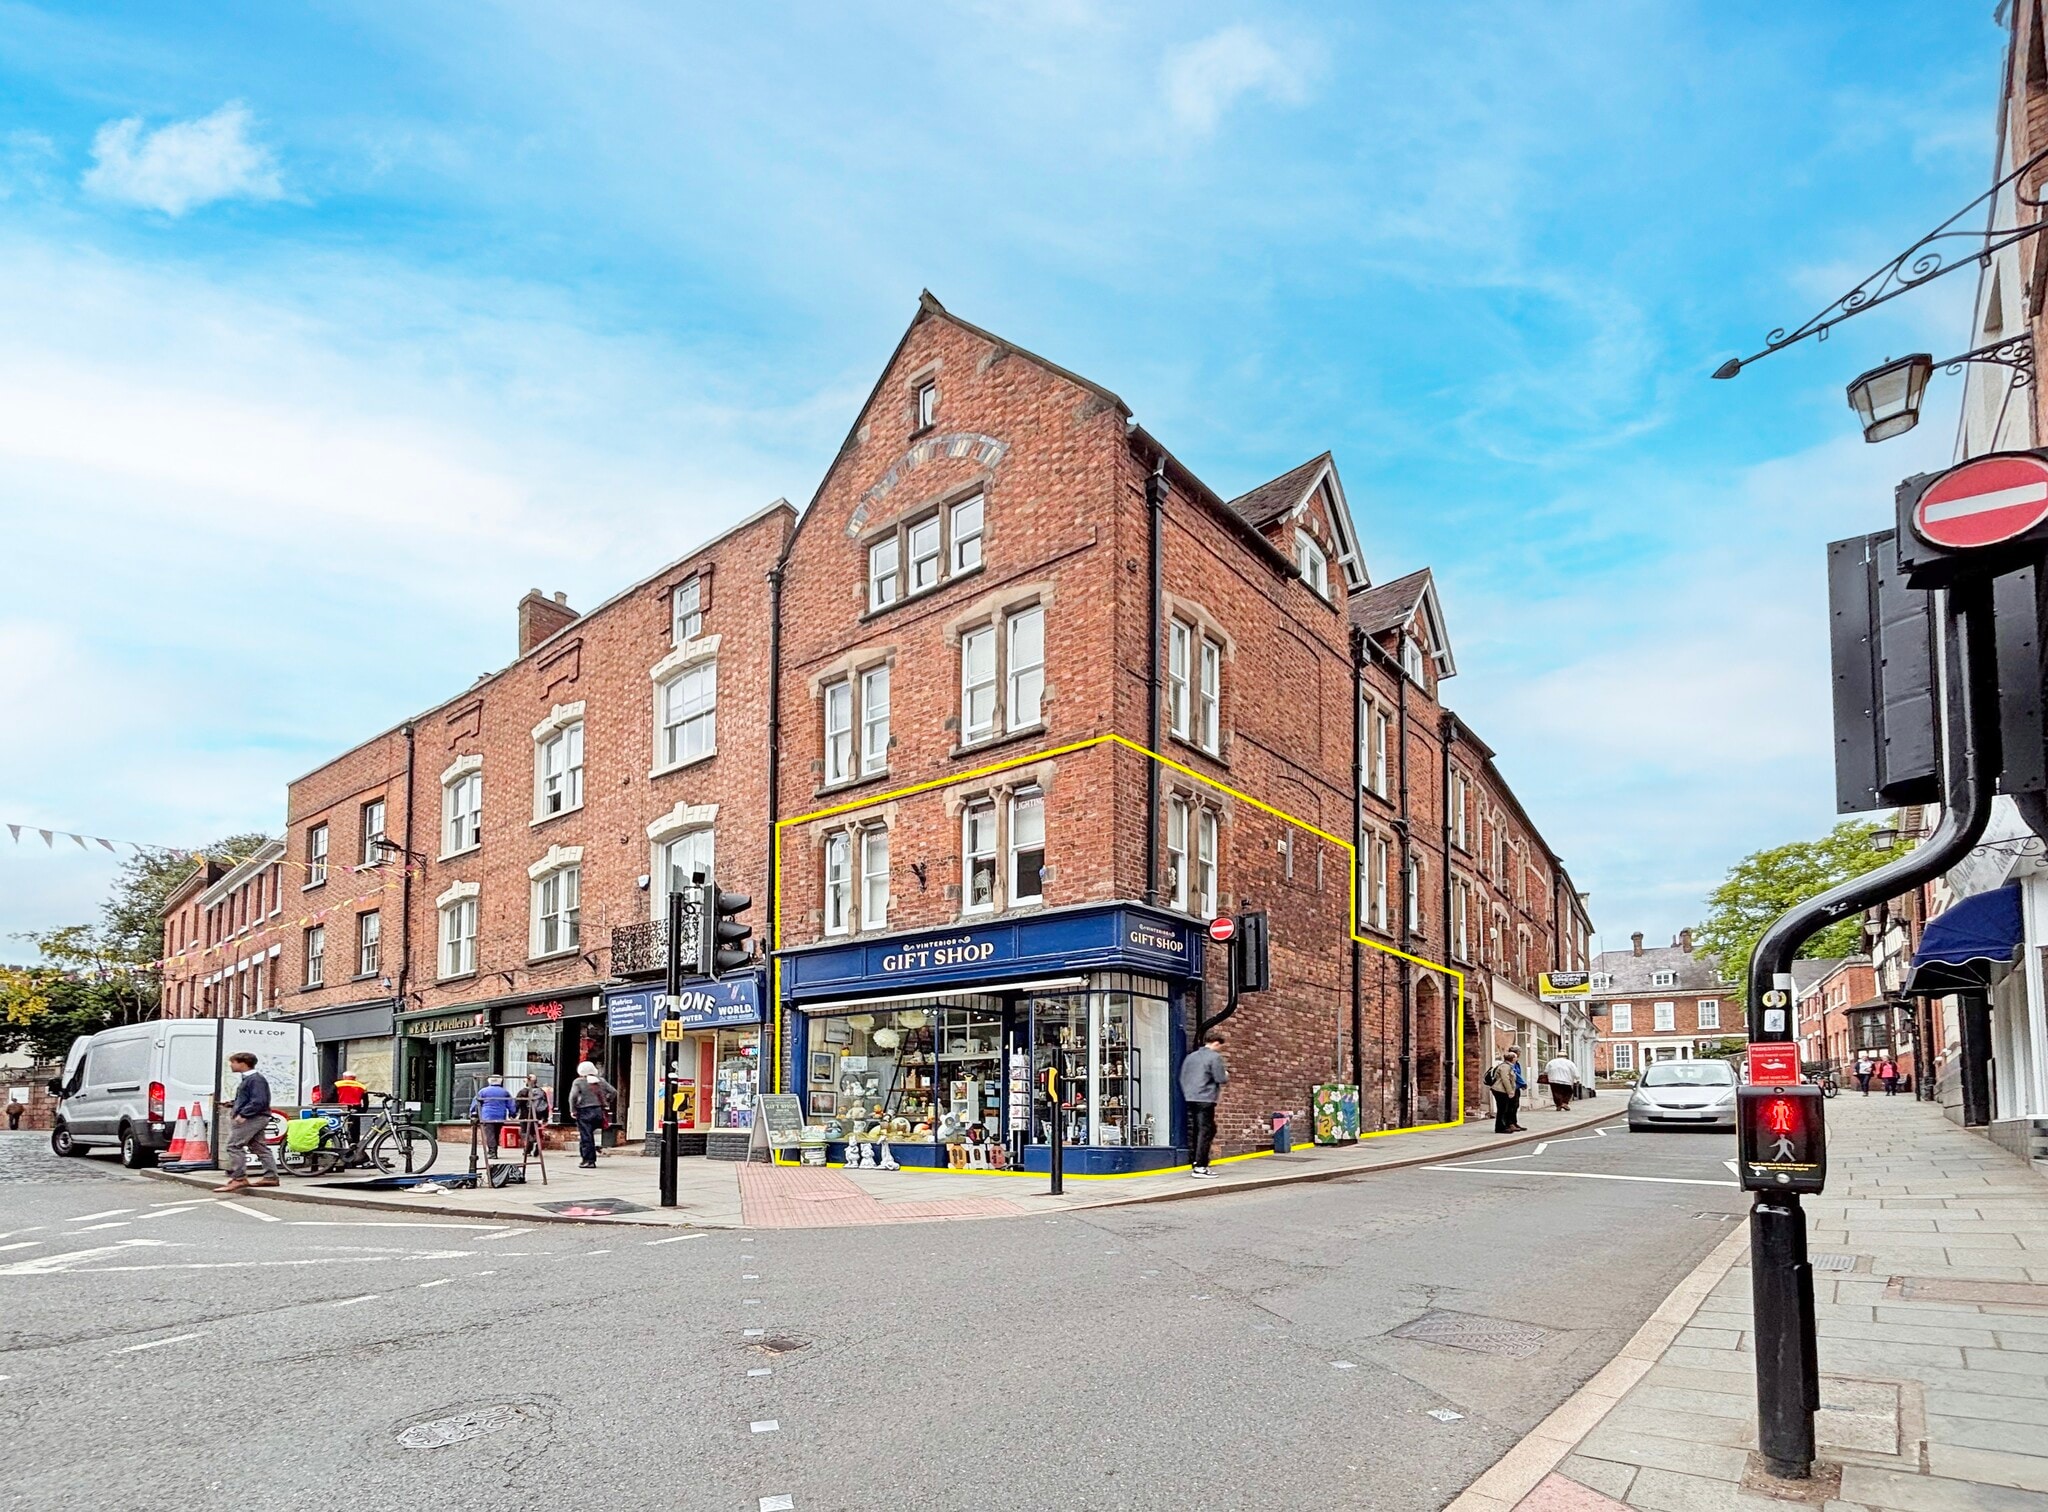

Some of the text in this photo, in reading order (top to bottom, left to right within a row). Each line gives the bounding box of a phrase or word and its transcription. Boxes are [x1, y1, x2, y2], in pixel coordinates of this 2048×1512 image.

[916, 938, 957, 949] VINTERIOR
[1130, 931, 1184, 952] GIFT SHOP
[883, 942, 994, 971] GIFT SHOP
[653, 992, 716, 1020] PONE
[679, 1014, 703, 1023] MPUTER
[665, 1022, 680, 1038] H
